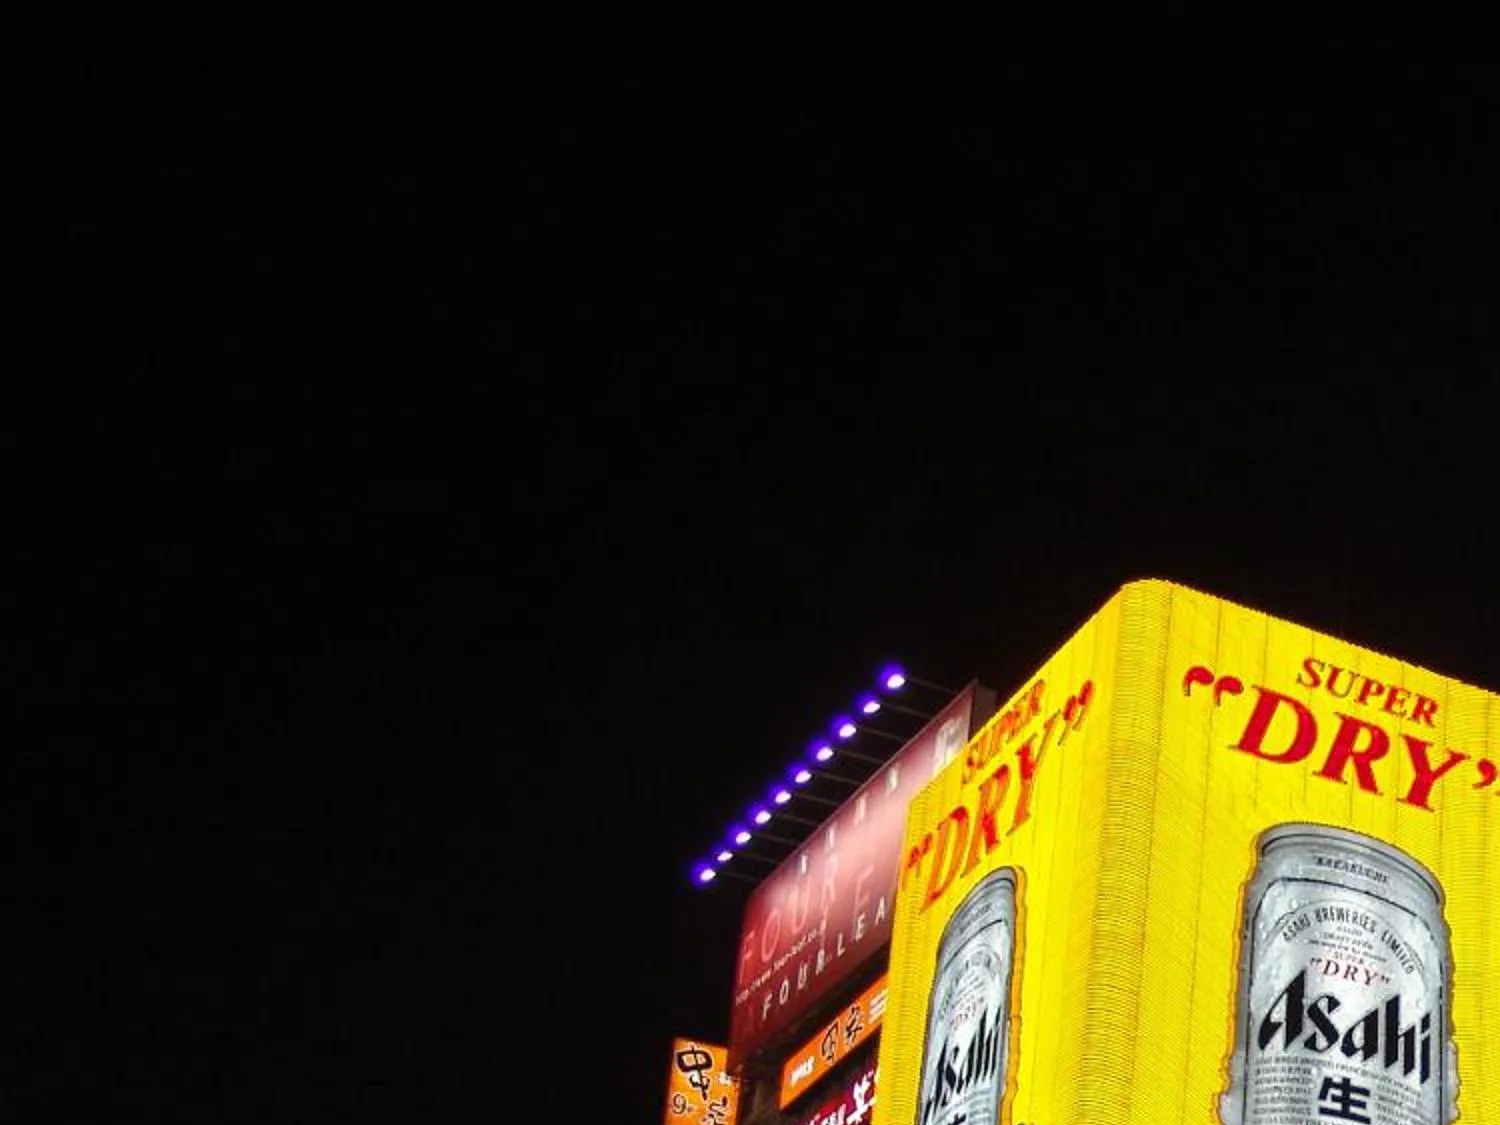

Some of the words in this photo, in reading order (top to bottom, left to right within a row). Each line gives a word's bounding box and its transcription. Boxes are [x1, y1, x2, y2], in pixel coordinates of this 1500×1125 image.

[1296, 656, 1439, 728] SUPER
[962, 680, 1045, 785] SUPER
[1315, 906, 1376, 933] BREWERIES
[1258, 970, 1430, 1085] Asahi
[1318, 1077, 1371, 1125] 生
